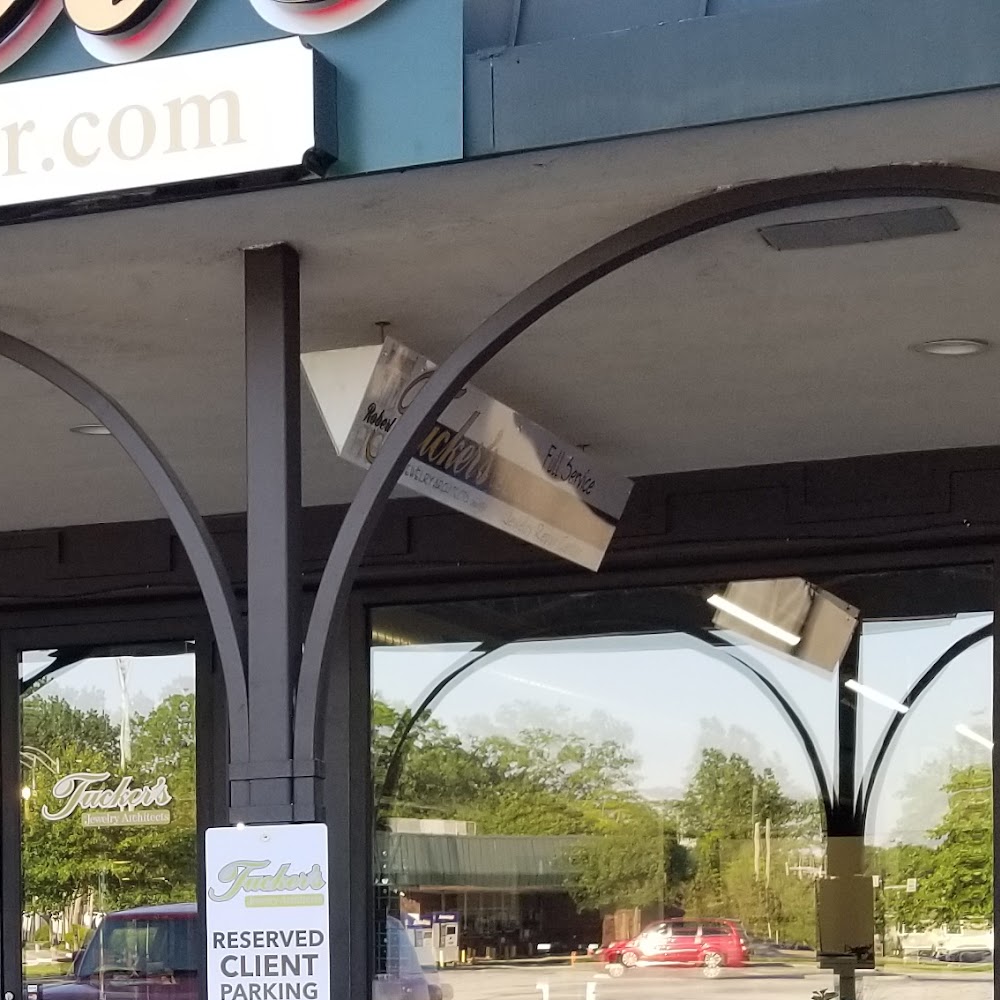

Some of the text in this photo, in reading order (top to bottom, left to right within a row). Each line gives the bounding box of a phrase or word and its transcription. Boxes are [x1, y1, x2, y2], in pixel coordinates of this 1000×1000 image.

[561, 457, 596, 495] Service
[85, 813, 169, 825] Jewelry Architects
[213, 930, 324, 949] RESERVED
[220, 954, 319, 977] CLIENT
[221, 982, 318, 1000] PARKING
